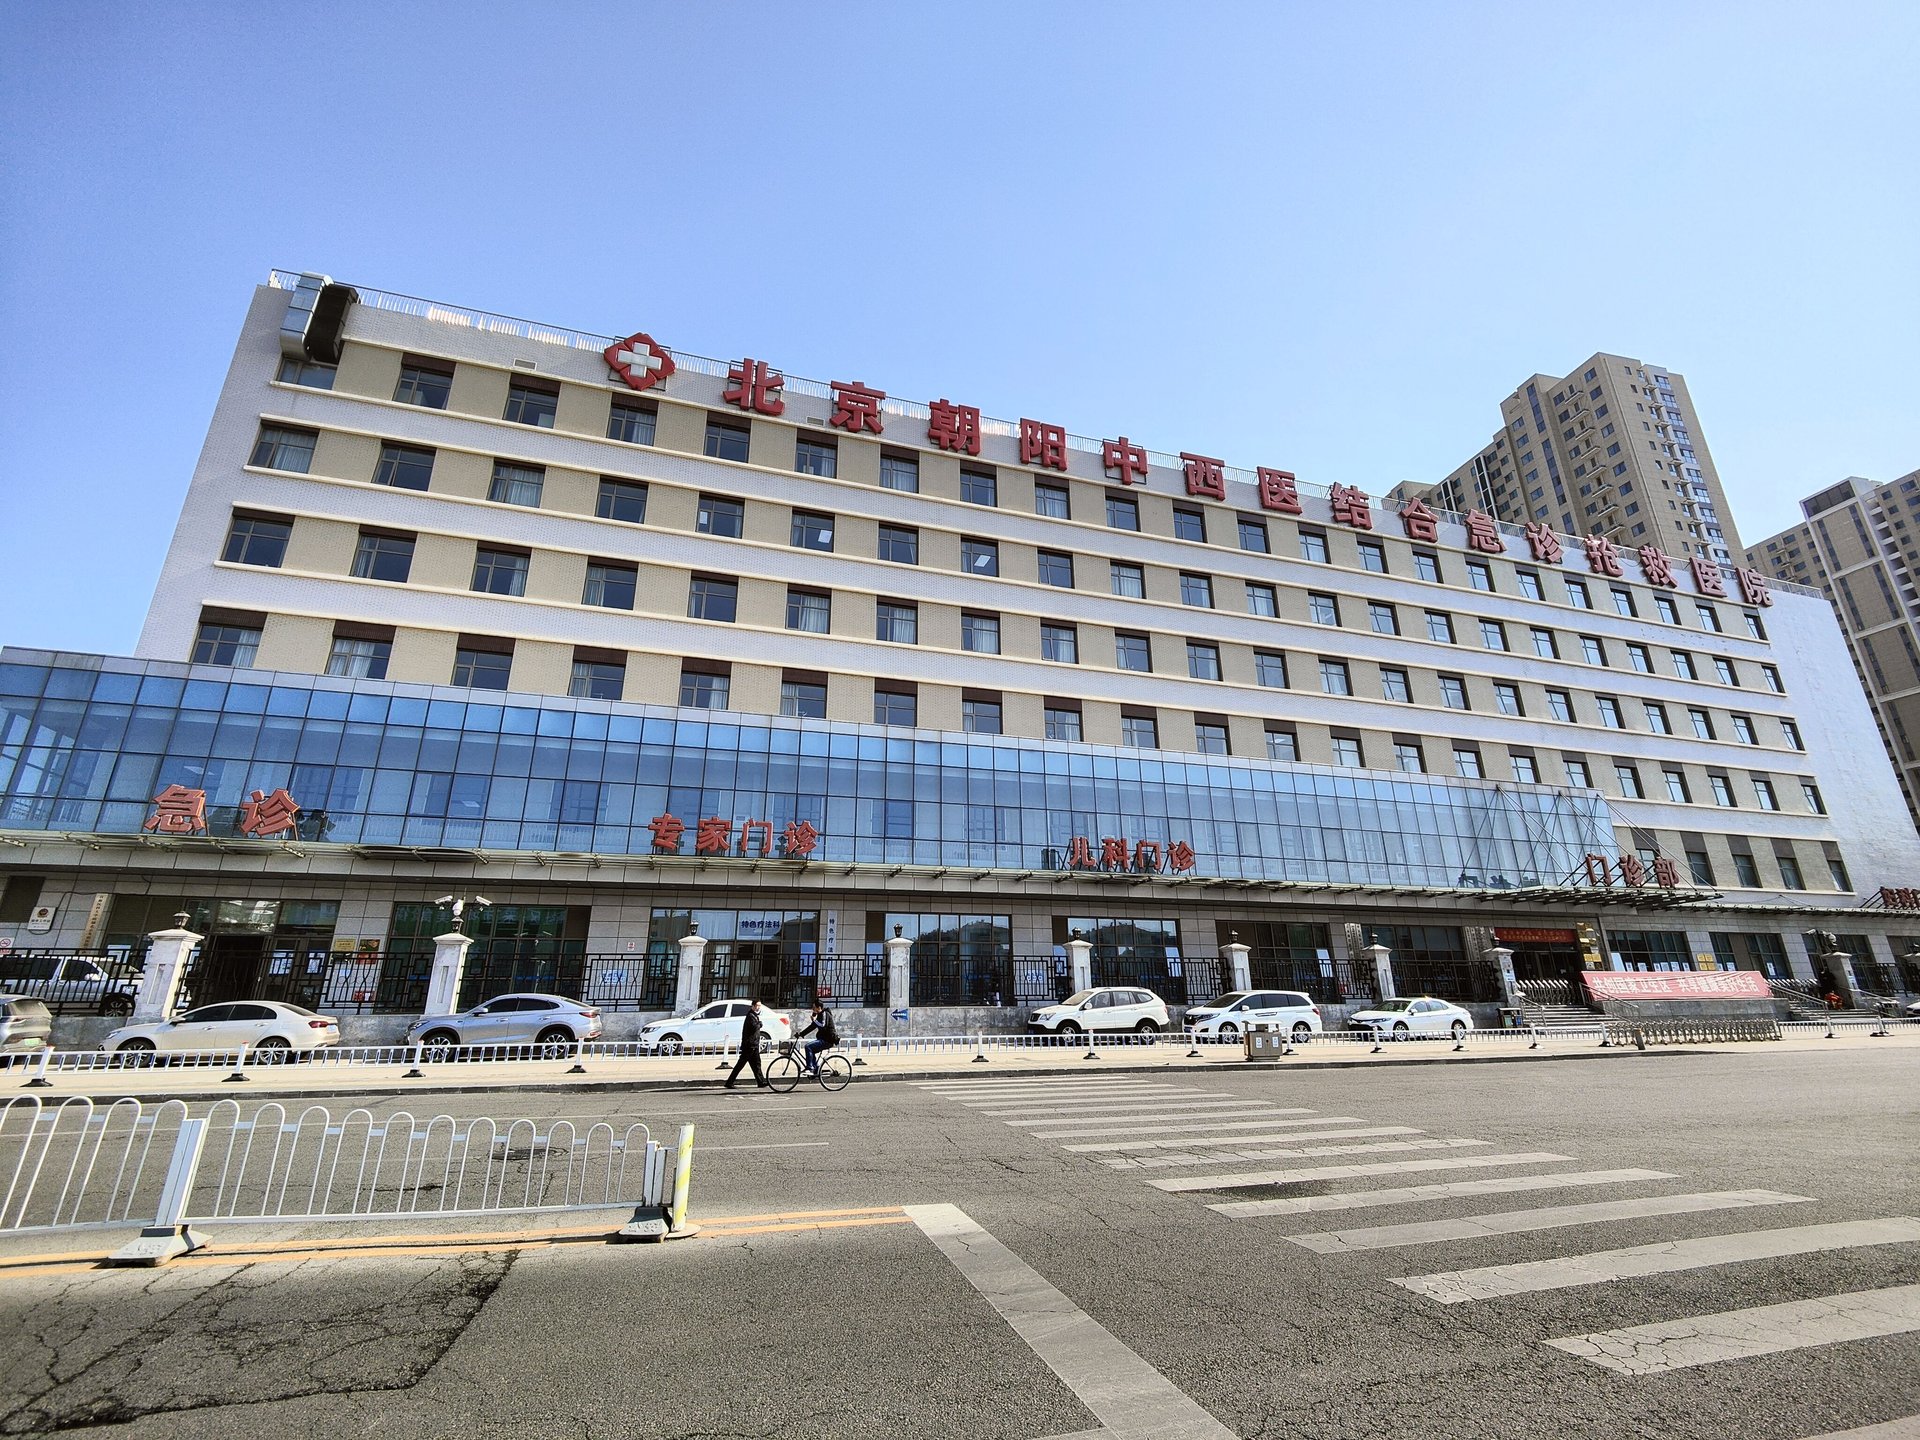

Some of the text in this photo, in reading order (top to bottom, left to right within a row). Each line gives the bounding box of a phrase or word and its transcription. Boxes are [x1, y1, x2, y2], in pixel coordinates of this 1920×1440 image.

[724, 357, 1774, 607] 北京朝阳中西医结合急诊抢救医院
[144, 784, 300, 837] 急诊
[648, 813, 818, 856] 专家门诊
[1068, 837, 1196, 871] 儿科门诊
[1585, 853, 1680, 889] 门诊部
[741, 920, 780, 929] 特色疗法科
